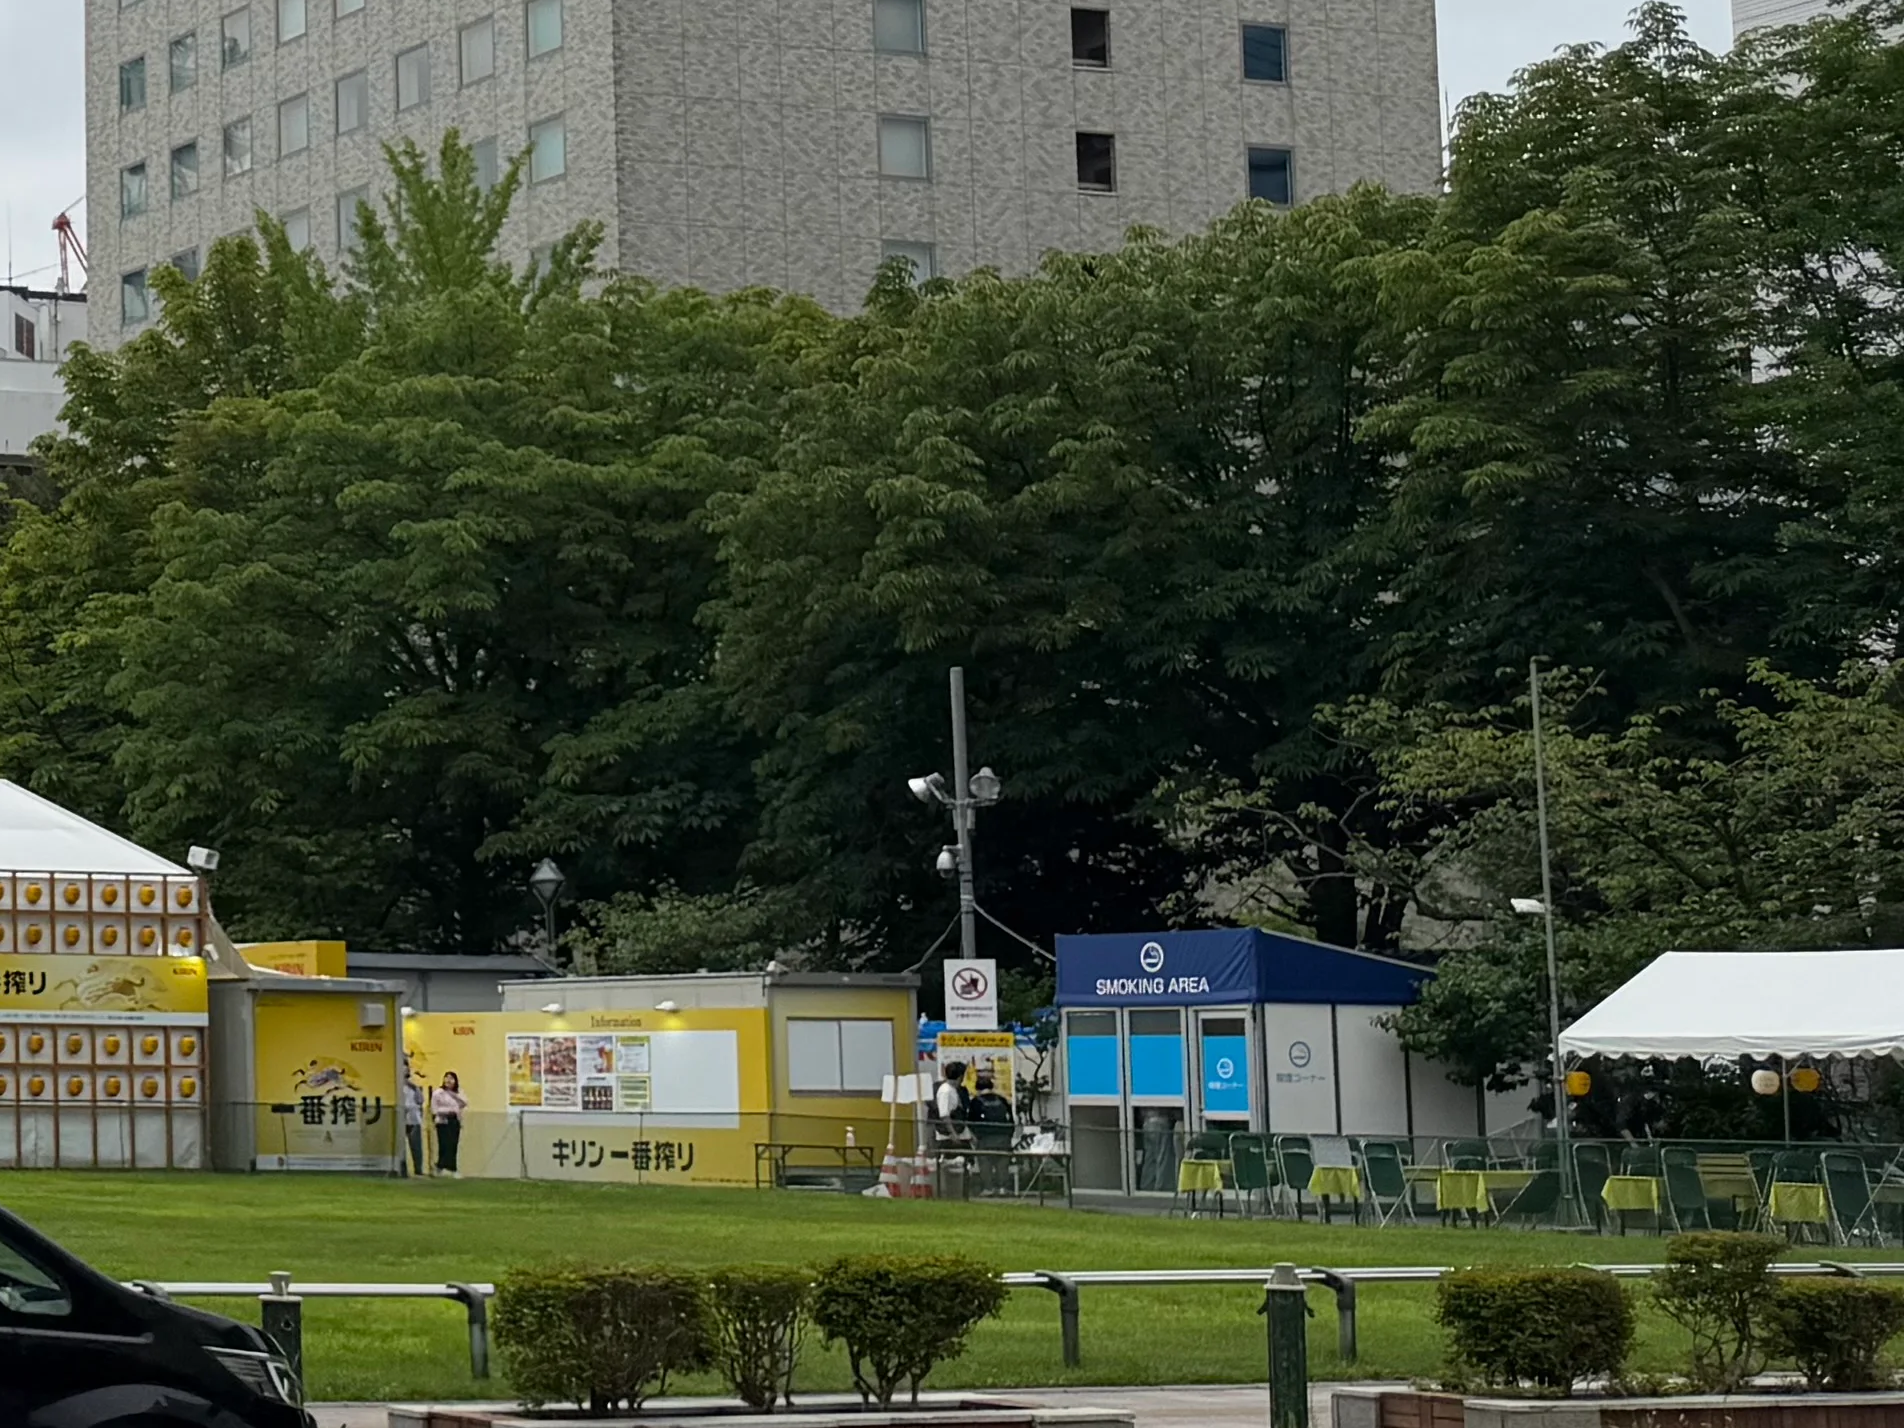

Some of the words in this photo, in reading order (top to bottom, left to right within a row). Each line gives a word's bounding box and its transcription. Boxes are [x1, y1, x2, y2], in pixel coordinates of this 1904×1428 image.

[1096, 978, 1164, 995] SMOKING
[1168, 977, 1210, 993] AREA
[351, 1042, 383, 1052] KIRIN
[271, 1094, 381, 1125] 一番搾り
